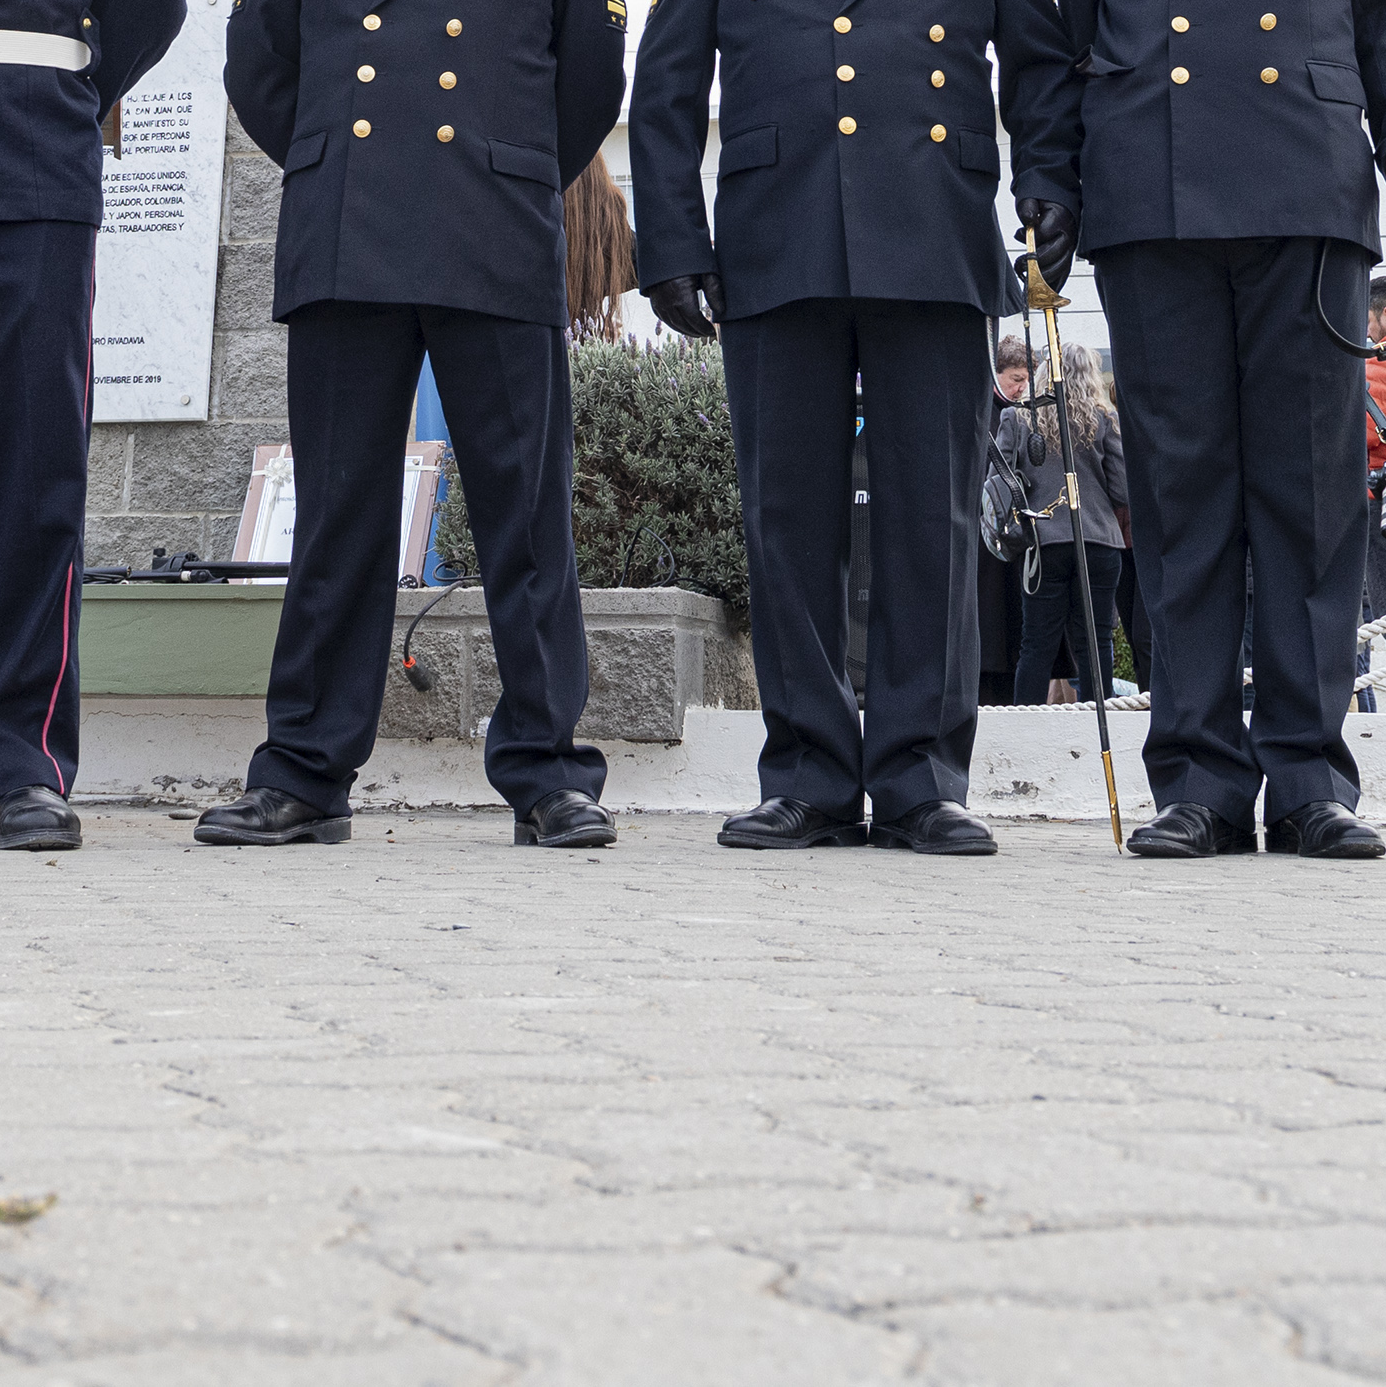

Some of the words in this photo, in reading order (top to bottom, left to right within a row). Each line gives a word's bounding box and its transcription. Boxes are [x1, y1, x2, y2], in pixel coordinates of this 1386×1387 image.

[133, 119, 176, 128] MANIFIESTO
[151, 131, 190, 141] PERSONAS
[135, 146, 176, 154] PORTUARIA
[111, 174, 120, 182] DE
[122, 172, 156, 181] ESTADOS
[157, 171, 187, 180] UNIDOS,
[144, 196, 185, 205] COLOMBIA,
[144, 210, 184, 218] PERSONAL
[119, 223, 177, 232] TRABAJADORES
[178, 222, 184, 230] Y
[94, 376, 131, 384] OVIEMBRE
[133, 375, 143, 384] DE
[145, 375, 161, 384] 2019
